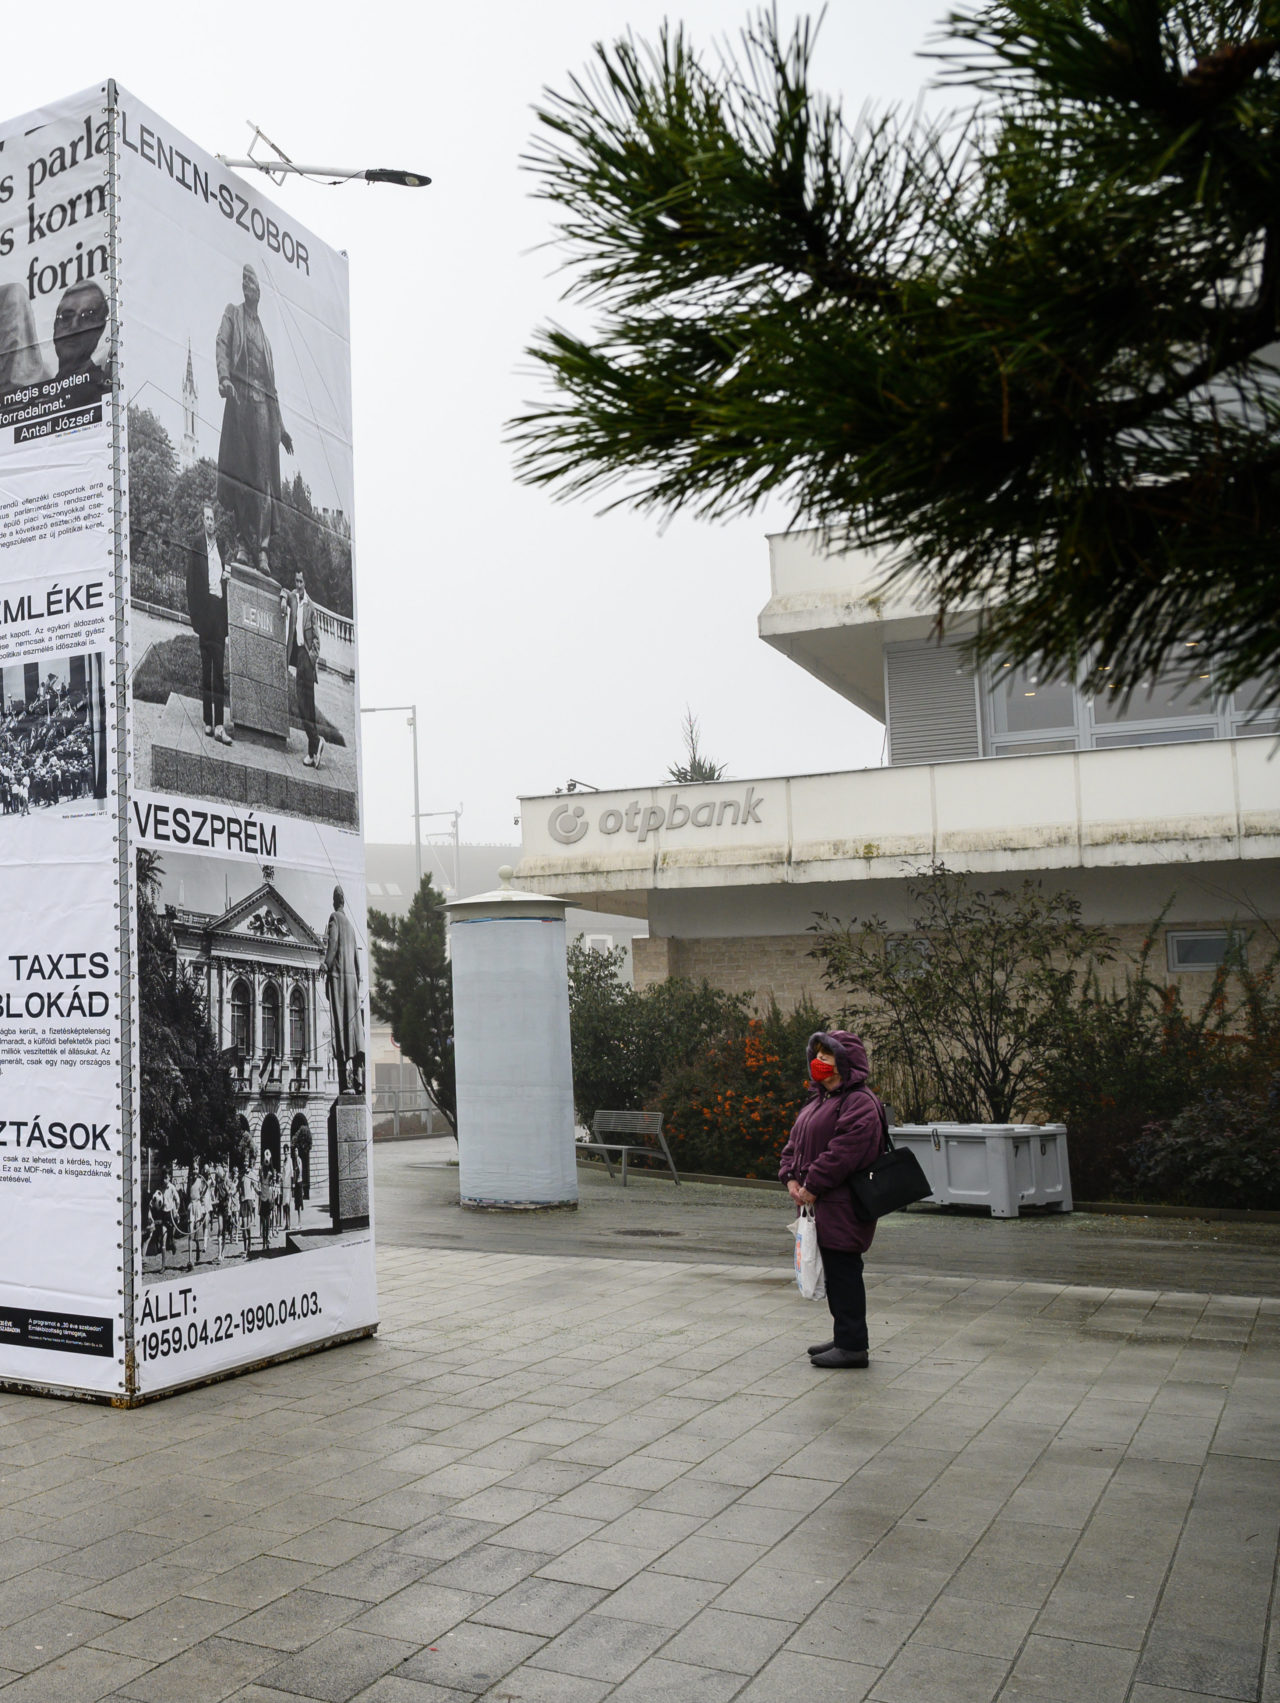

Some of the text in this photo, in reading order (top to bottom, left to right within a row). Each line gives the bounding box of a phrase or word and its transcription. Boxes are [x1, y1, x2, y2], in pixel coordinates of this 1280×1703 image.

[122, 111, 310, 276] LENIN-SZOBOR
[4, 387, 39, 405] mégis
[42, 374, 90, 396] egyetlen
[20, 420, 52, 439] Antall
[55, 409, 95, 430] József
[242, 605, 273, 633] LENIN
[133, 800, 277, 857] VESZPRÉM
[598, 786, 764, 842] otpbank
[8, 952, 109, 980] TAXIS
[141, 1289, 197, 1326] ÁLLT:
[141, 1292, 322, 1361] 1959.04.22-1990.04.03.
